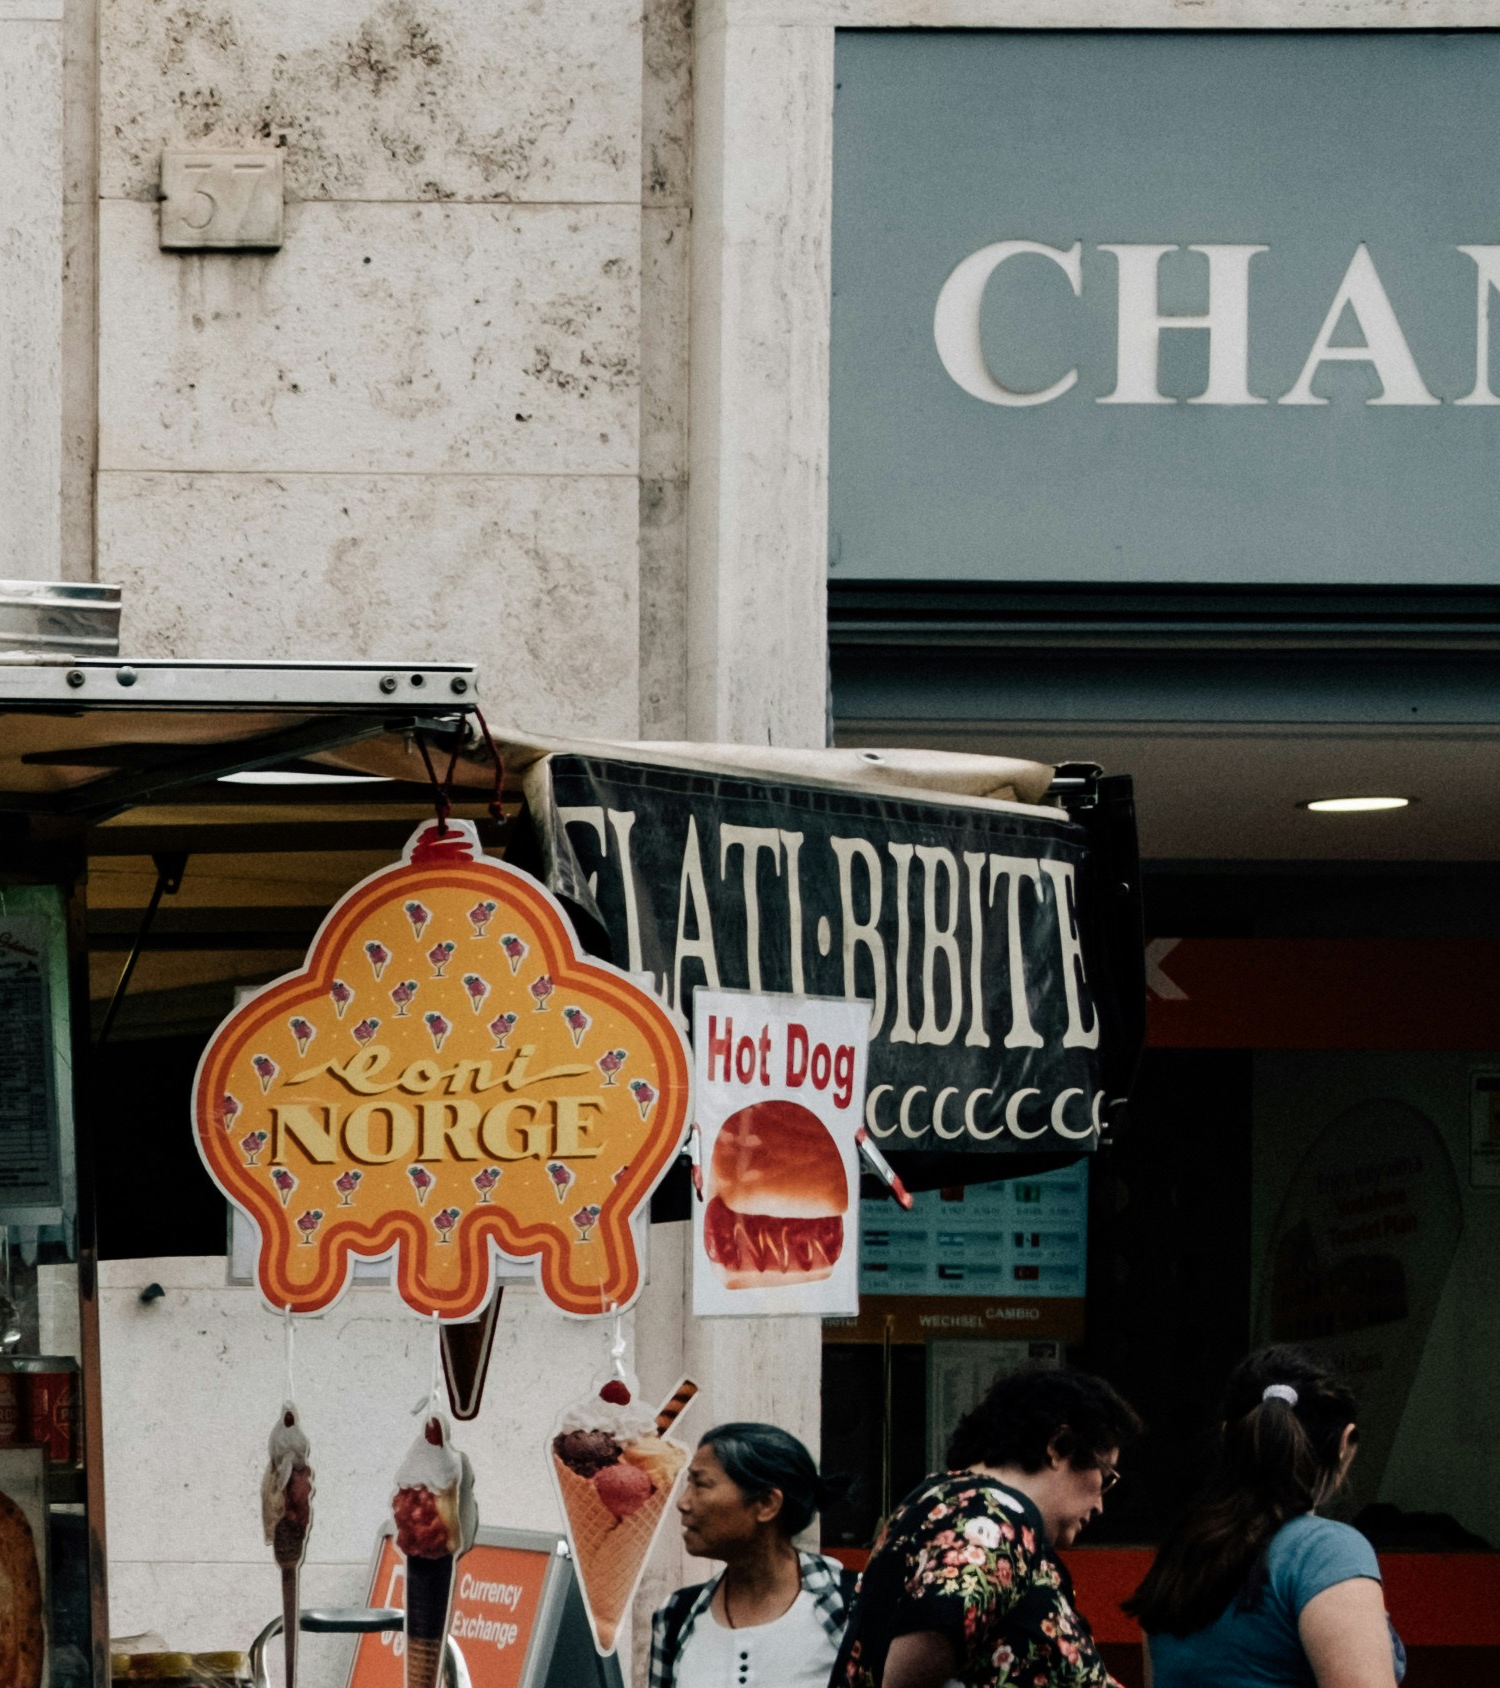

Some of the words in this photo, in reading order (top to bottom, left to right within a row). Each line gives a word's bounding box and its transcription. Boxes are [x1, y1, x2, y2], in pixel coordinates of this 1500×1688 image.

[184, 160, 266, 231] 37
[933, 238, 1500, 408] CHA
[705, 1014, 772, 1086] Hot
[785, 1021, 857, 1111] Dog
[267, 1095, 608, 1166] NORGE
[919, 1314, 985, 1329] WECHSEL
[985, 1307, 1040, 1320] CAMBIO
[459, 1573, 522, 1613] Currency
[451, 1610, 518, 1650] Exchange
